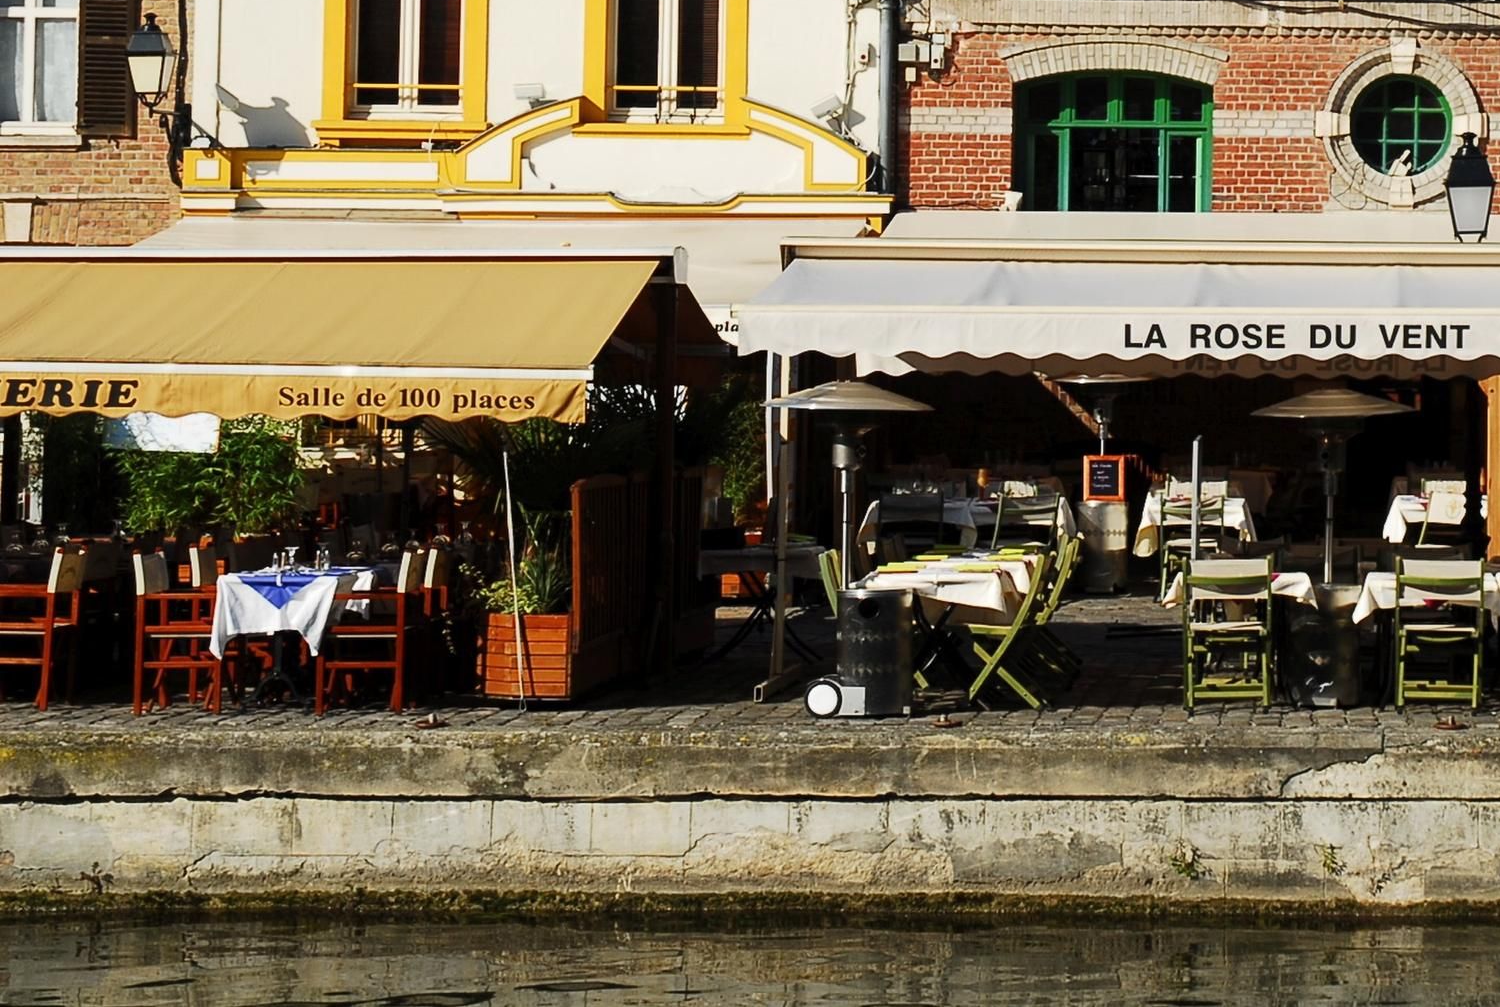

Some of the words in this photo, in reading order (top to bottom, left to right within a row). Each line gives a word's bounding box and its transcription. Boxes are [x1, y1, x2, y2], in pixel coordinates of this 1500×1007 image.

[1125, 324, 1166, 348] LA
[1190, 324, 1285, 349] ROSE
[1309, 324, 1356, 349] DU
[1379, 324, 1470, 349] VENT
[0, 379, 139, 407] ERIE
[278, 387, 345, 407] Salle
[356, 388, 386, 407] de
[400, 388, 440, 408] 100
[453, 390, 536, 413] places
